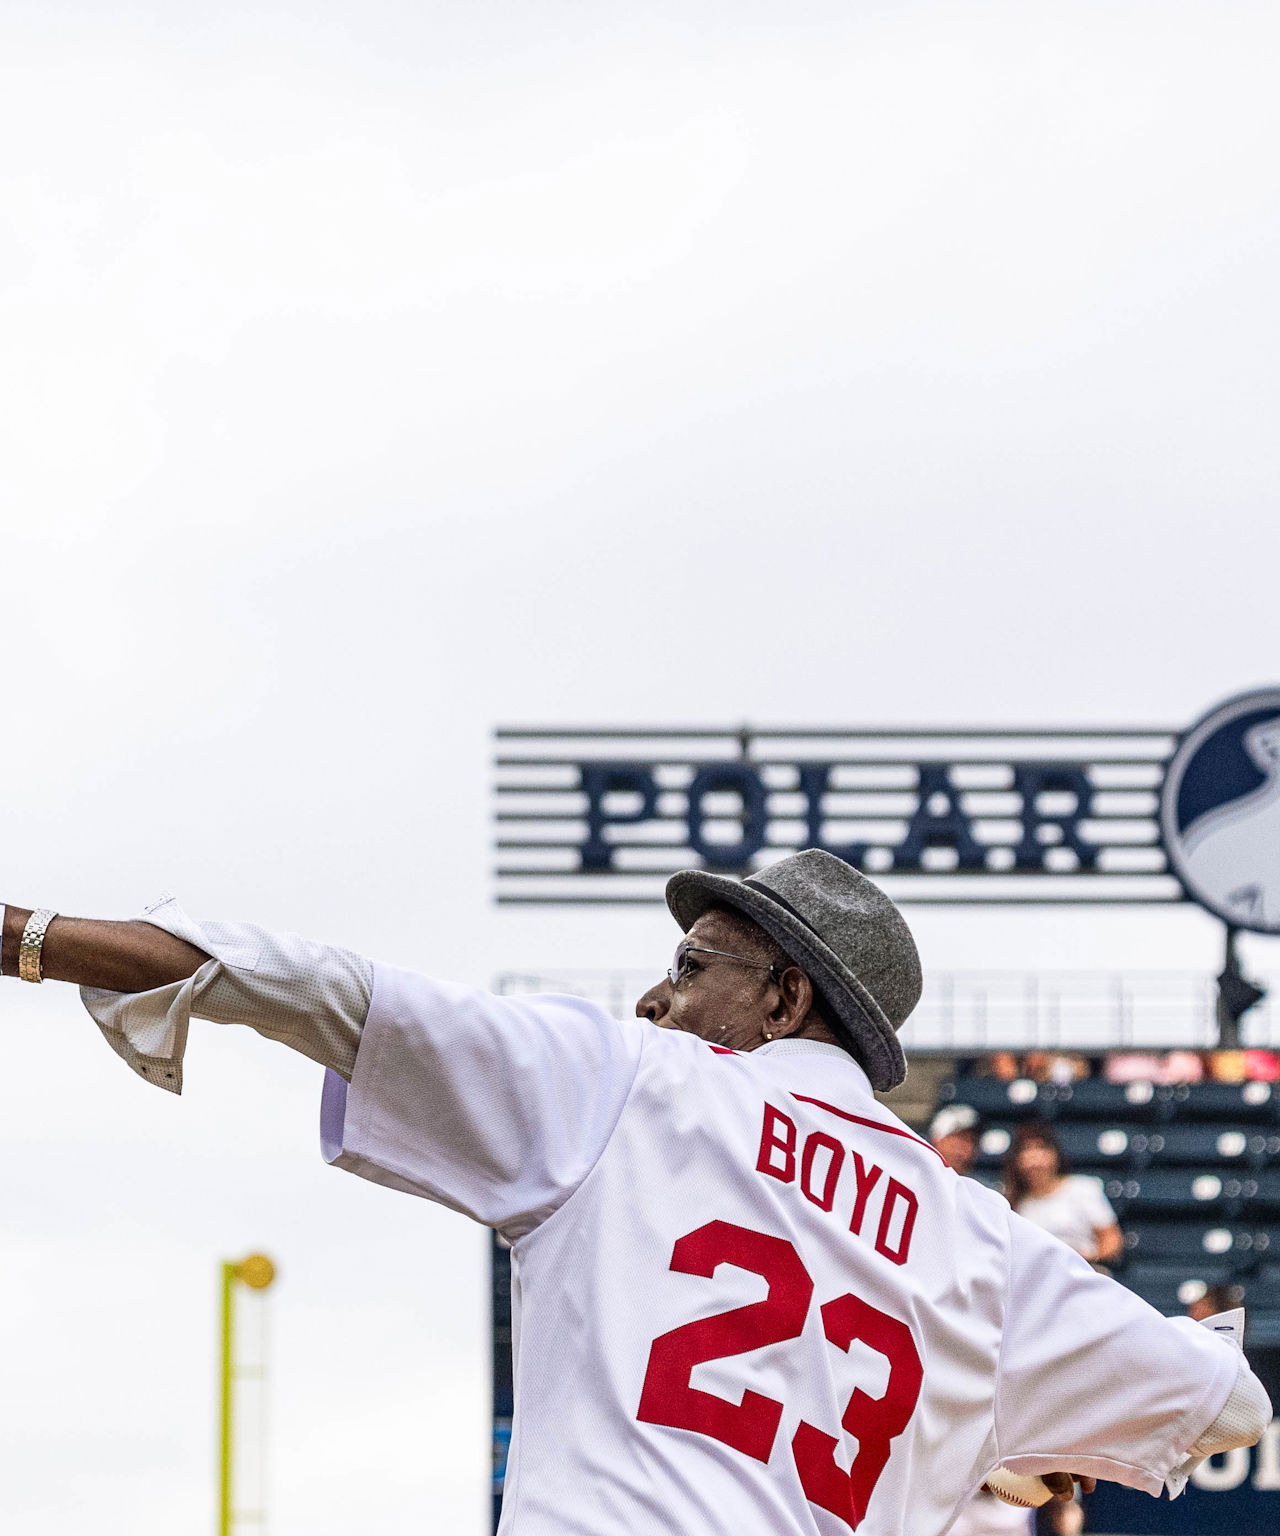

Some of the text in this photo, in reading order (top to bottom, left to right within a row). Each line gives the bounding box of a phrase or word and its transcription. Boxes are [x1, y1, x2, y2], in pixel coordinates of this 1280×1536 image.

[580, 761, 1098, 874] POLAR
[754, 1100, 920, 1267] BOYD
[635, 1218, 924, 1533] 23
